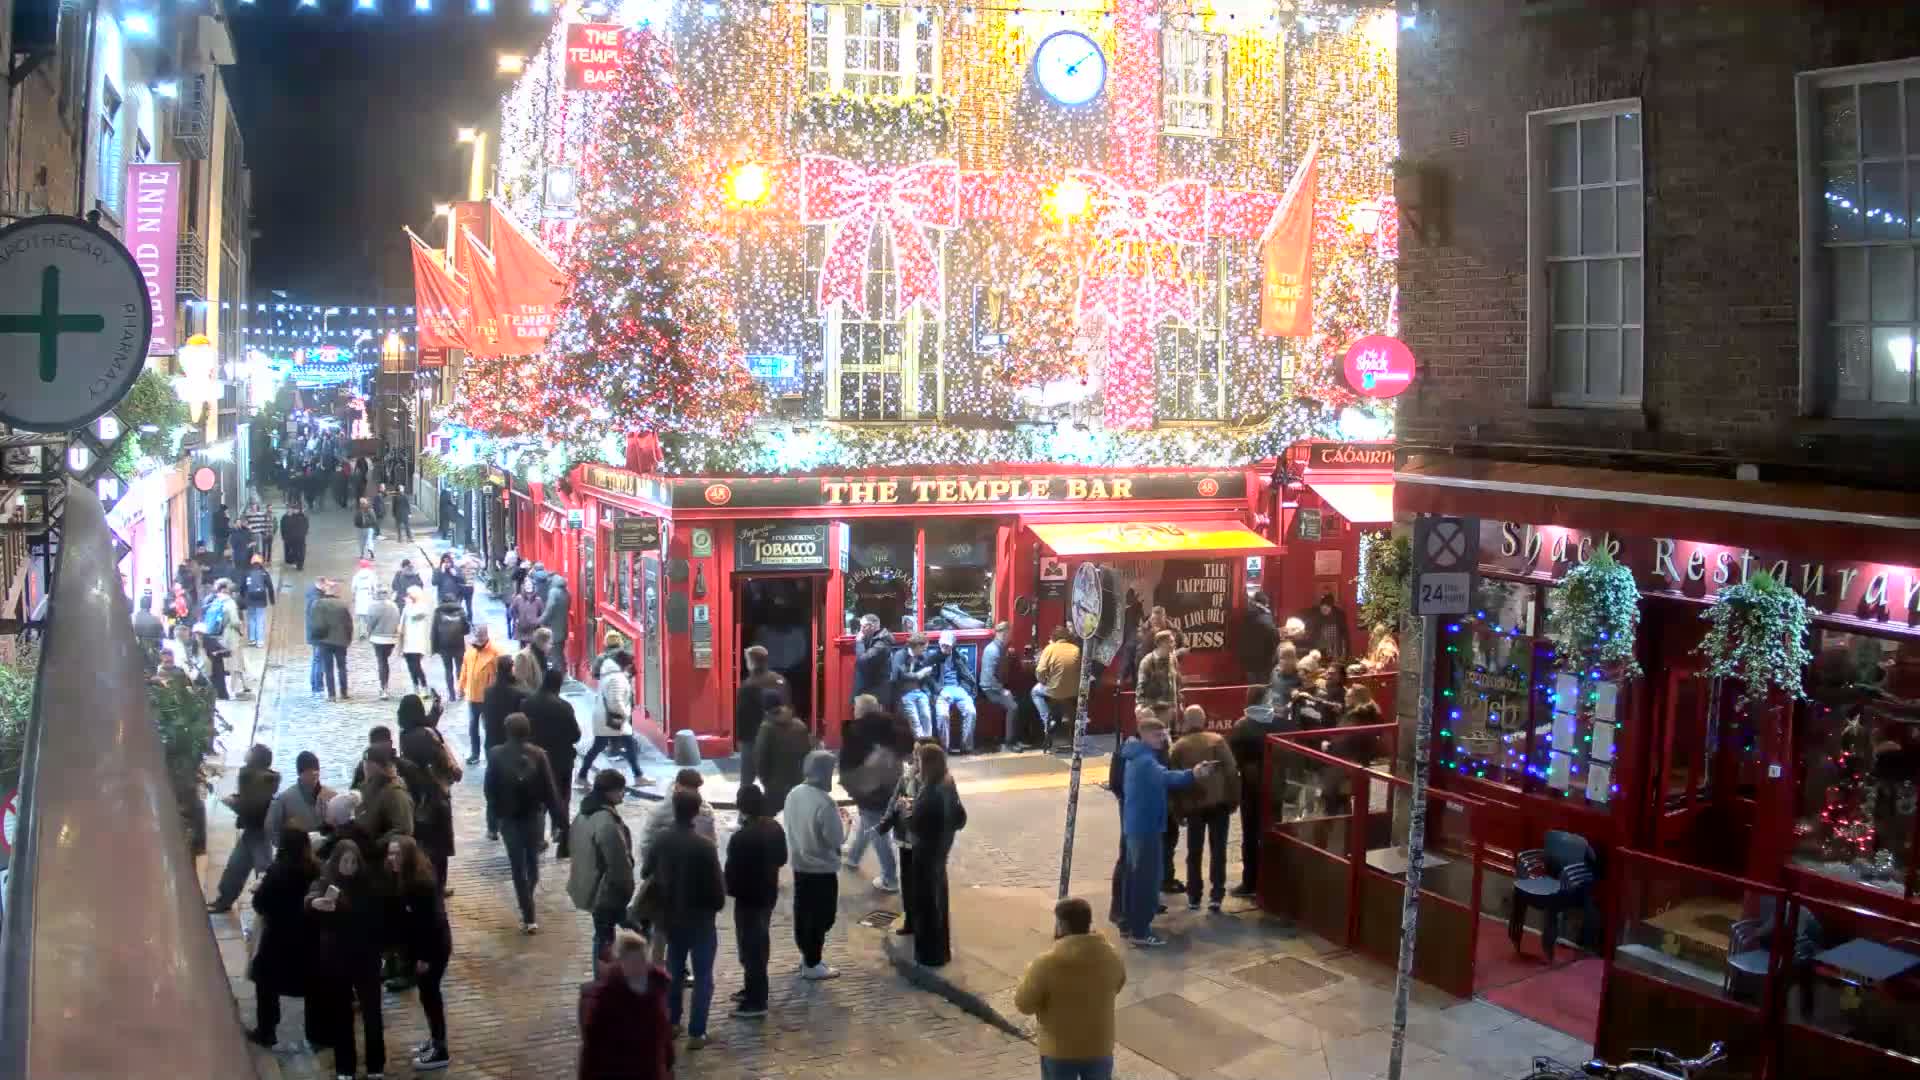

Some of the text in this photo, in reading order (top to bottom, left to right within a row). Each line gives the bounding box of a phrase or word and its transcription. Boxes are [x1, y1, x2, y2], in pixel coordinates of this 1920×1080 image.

[585, 29, 618, 46] THE
[568, 47, 623, 64] TEMPL
[136, 171, 170, 234] NINE
[519, 304, 546, 313] THE
[501, 313, 553, 326] TEMPL
[90, 303, 137, 401] PHARMACY
[824, 477, 1133, 504] THE TEMPLE BAR
[750, 539, 817, 562] TOBACCO
[1204, 563, 1227, 578] THE
[1501, 520, 1920, 613] Shack Restauran
[1176, 578, 1227, 593] EMPEROR
[1422, 584, 1443, 603] 24
